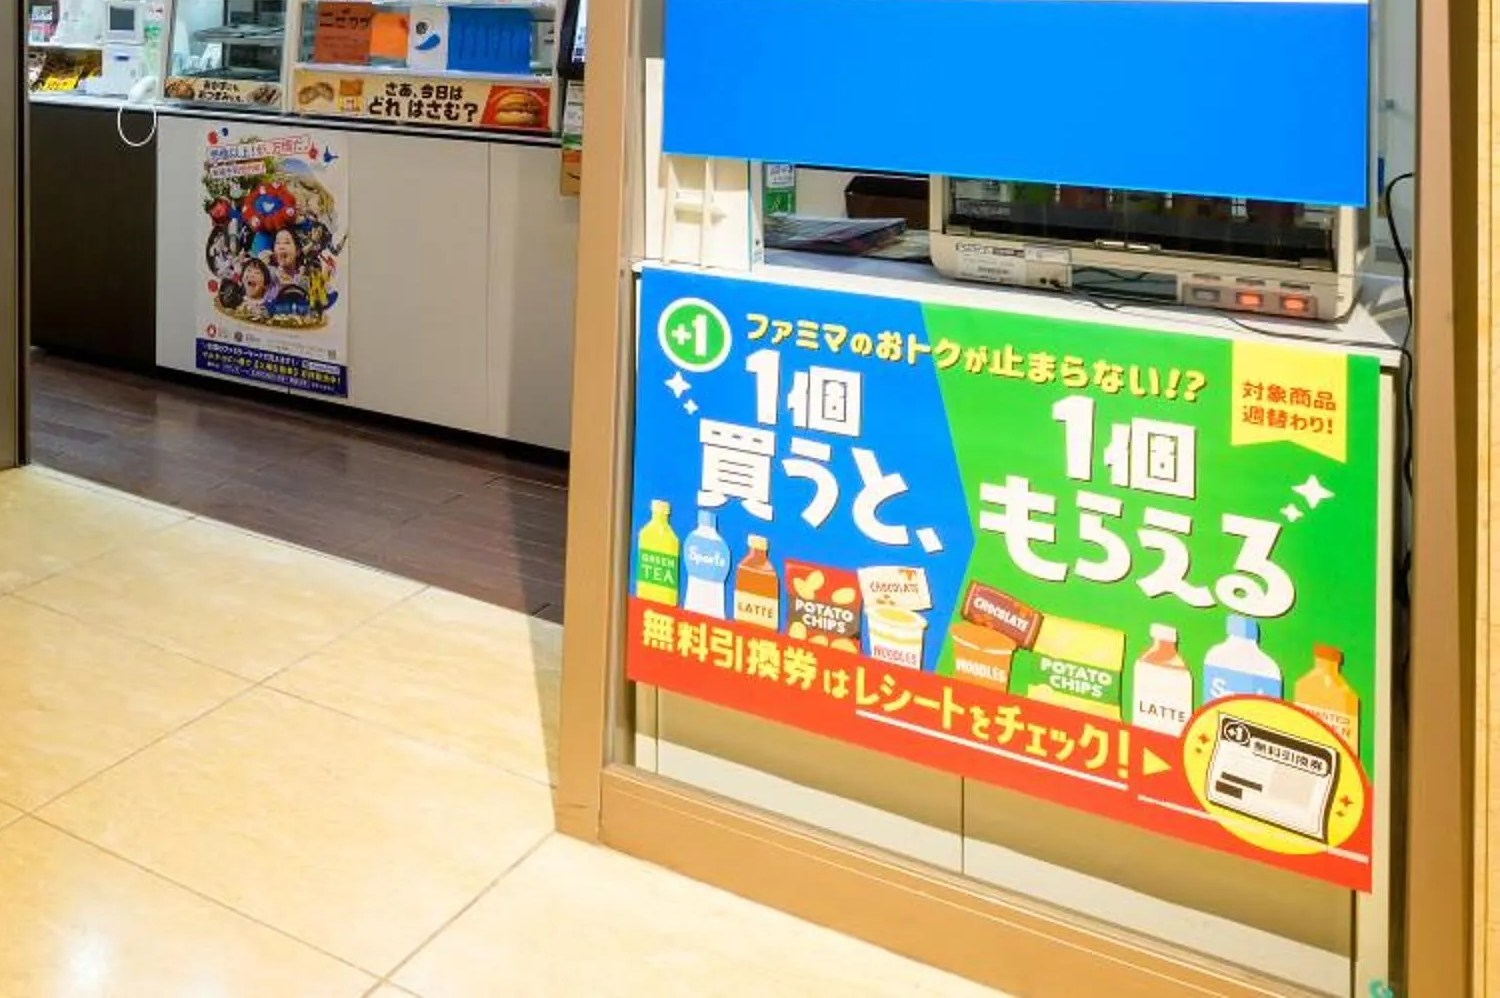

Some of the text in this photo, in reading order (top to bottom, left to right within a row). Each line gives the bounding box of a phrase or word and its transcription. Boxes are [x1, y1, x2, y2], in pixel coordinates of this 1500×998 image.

[385, 82, 463, 101] さあ、今日は
[670, 314, 708, 357] +1
[746, 313, 1207, 402] ファミマのおトクが止まらない!?
[745, 349, 862, 438] 1個
[1241, 381, 1337, 412] 対象商品
[1241, 405, 1334, 435] 週替わり!
[1052, 394, 1197, 500] 1個
[696, 418, 944, 554] 買うと、
[641, 553, 676, 566] GREEN
[688, 546, 726, 569] Sports
[979, 474, 1297, 619] もらえる
[642, 565, 675, 583] TEA
[738, 600, 774, 620] LATTE
[795, 599, 854, 624] POTATO
[802, 613, 847, 634] CHIPS
[973, 596, 1029, 633] CHOCOLATE
[873, 644, 918, 667] NOODLES
[955, 657, 1007, 683] NOODLES
[1040, 657, 1113, 685] POTATO
[642, 609, 1131, 780] 無料引換券はレシートをチェック!
[1048, 673, 1104, 698] CHIPS
[1138, 700, 1187, 723] LATTE
